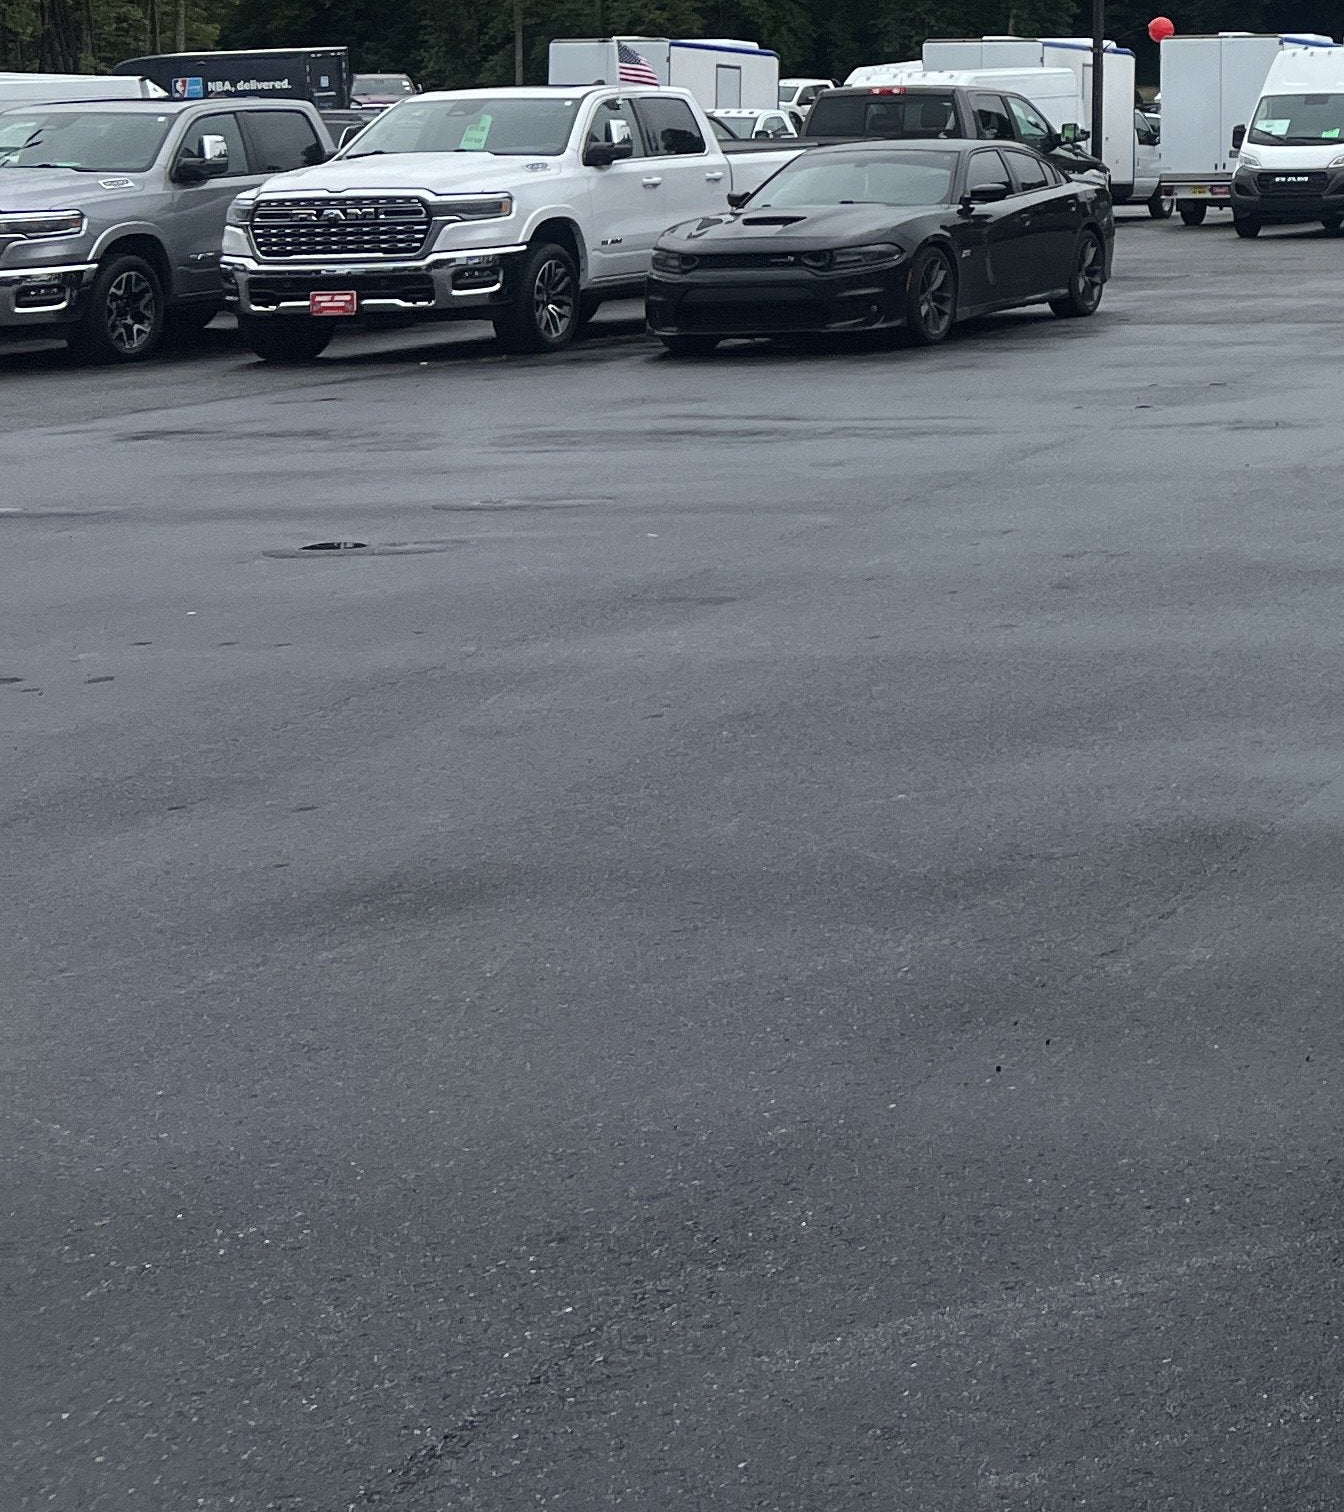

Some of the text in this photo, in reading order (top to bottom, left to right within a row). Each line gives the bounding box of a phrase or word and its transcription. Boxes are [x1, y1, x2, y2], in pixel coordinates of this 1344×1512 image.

[207, 81, 235, 92] NBA,
[237, 79, 292, 91] delivered.
[291, 208, 375, 221] RAM
